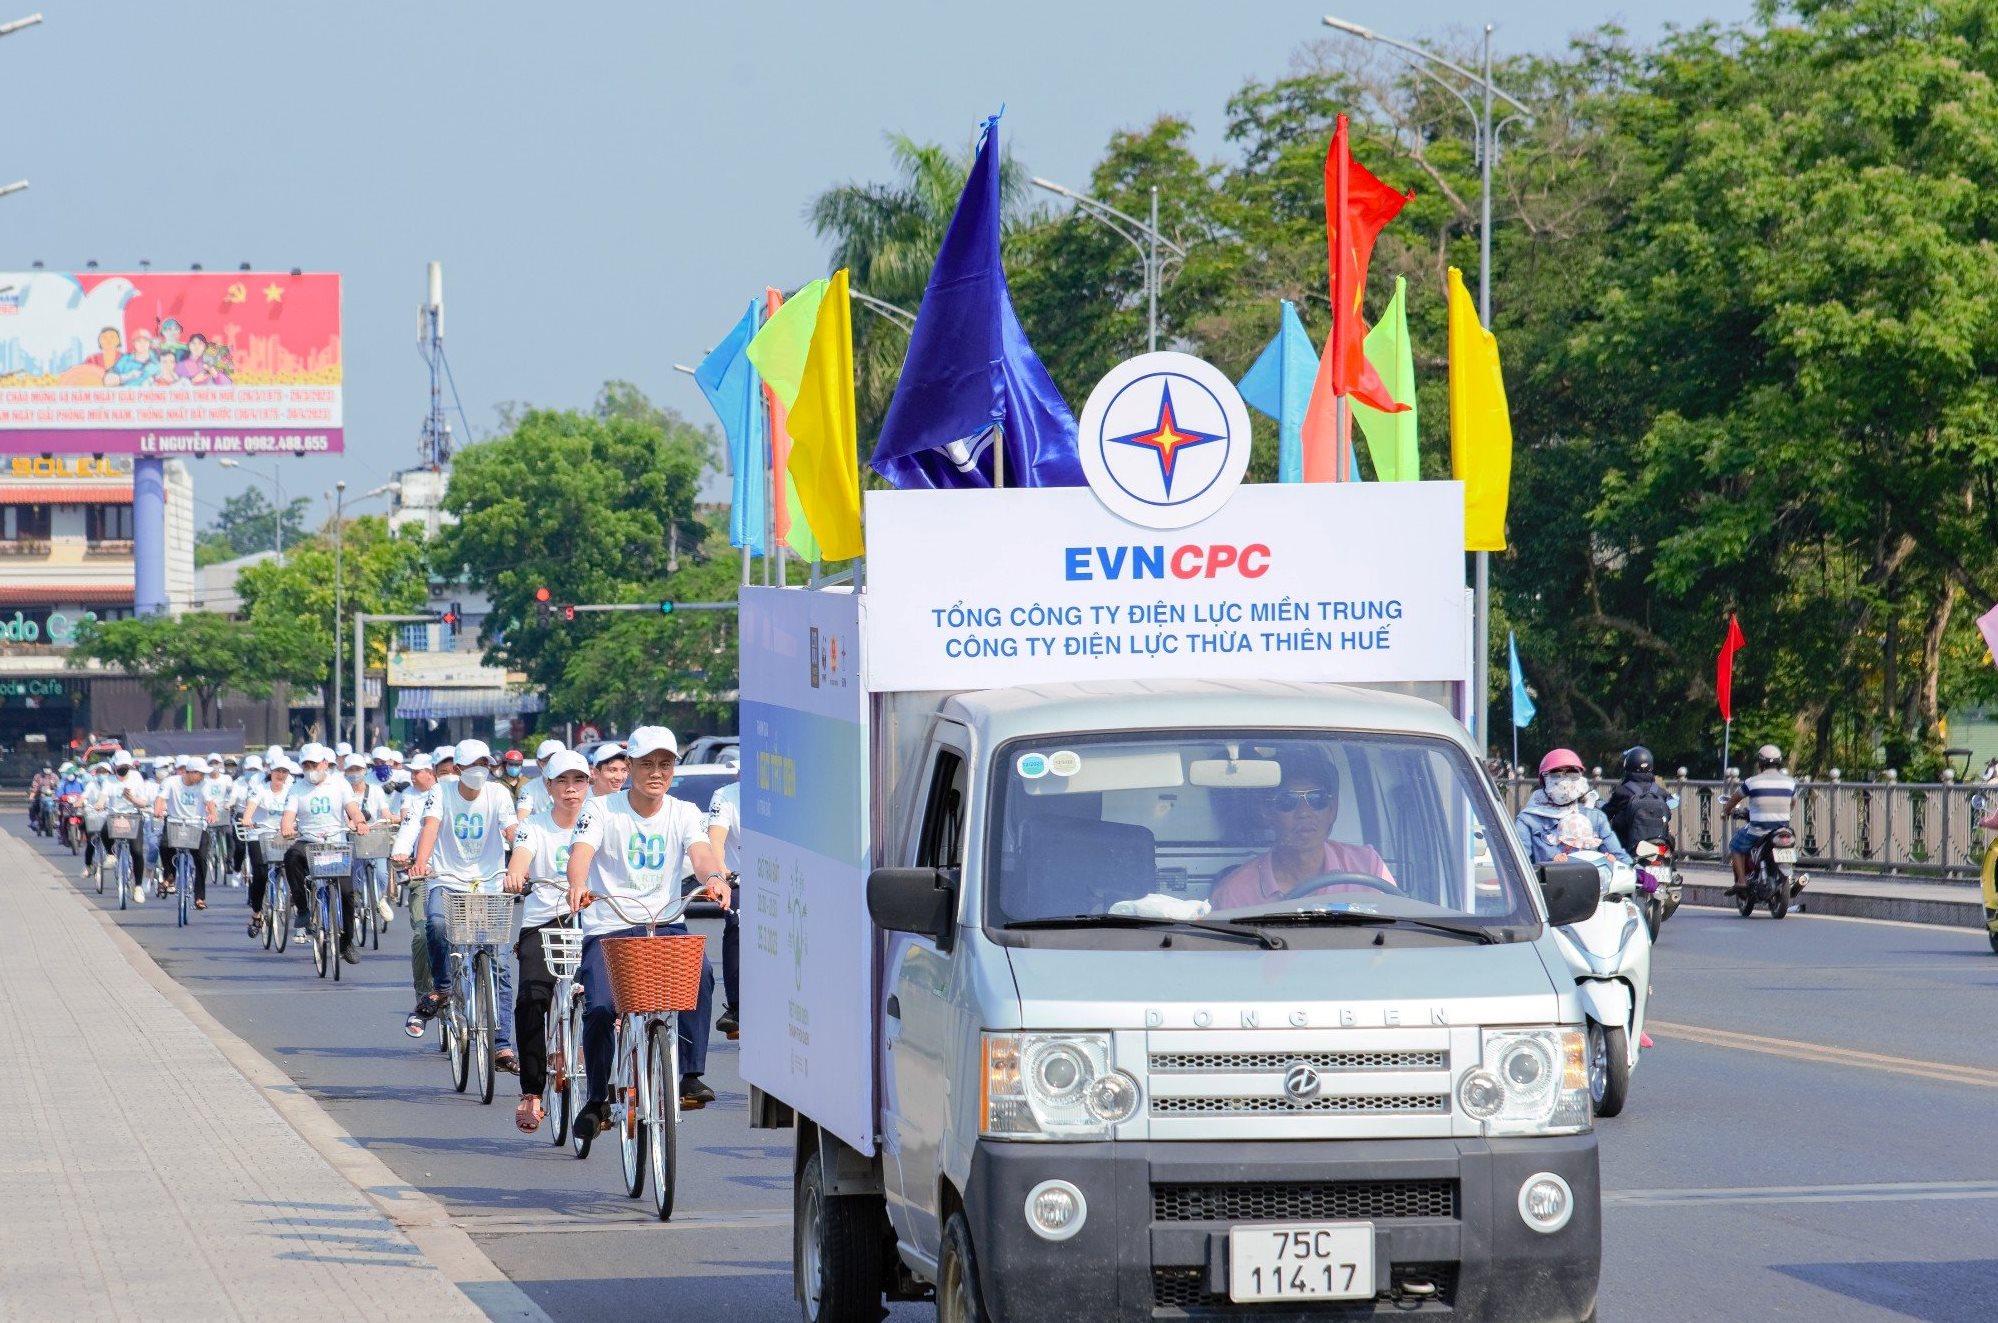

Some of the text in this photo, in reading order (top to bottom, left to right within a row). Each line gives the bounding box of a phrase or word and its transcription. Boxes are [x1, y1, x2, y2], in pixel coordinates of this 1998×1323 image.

[931, 596, 1403, 628] TỔNG CÔNG TY ĐIỆN LỰC MIỀN TRUNG
[945, 623, 1391, 660] CÔNG TY ĐIỆN LỰC THỪA THIÊN HUẾ
[454, 812, 484, 840] 60
[627, 832, 665, 871] 60
[1145, 1007, 1449, 1029] DONGBEN
[1272, 1231, 1331, 1259] 75C
[1252, 1264, 1356, 1293] 114.17
